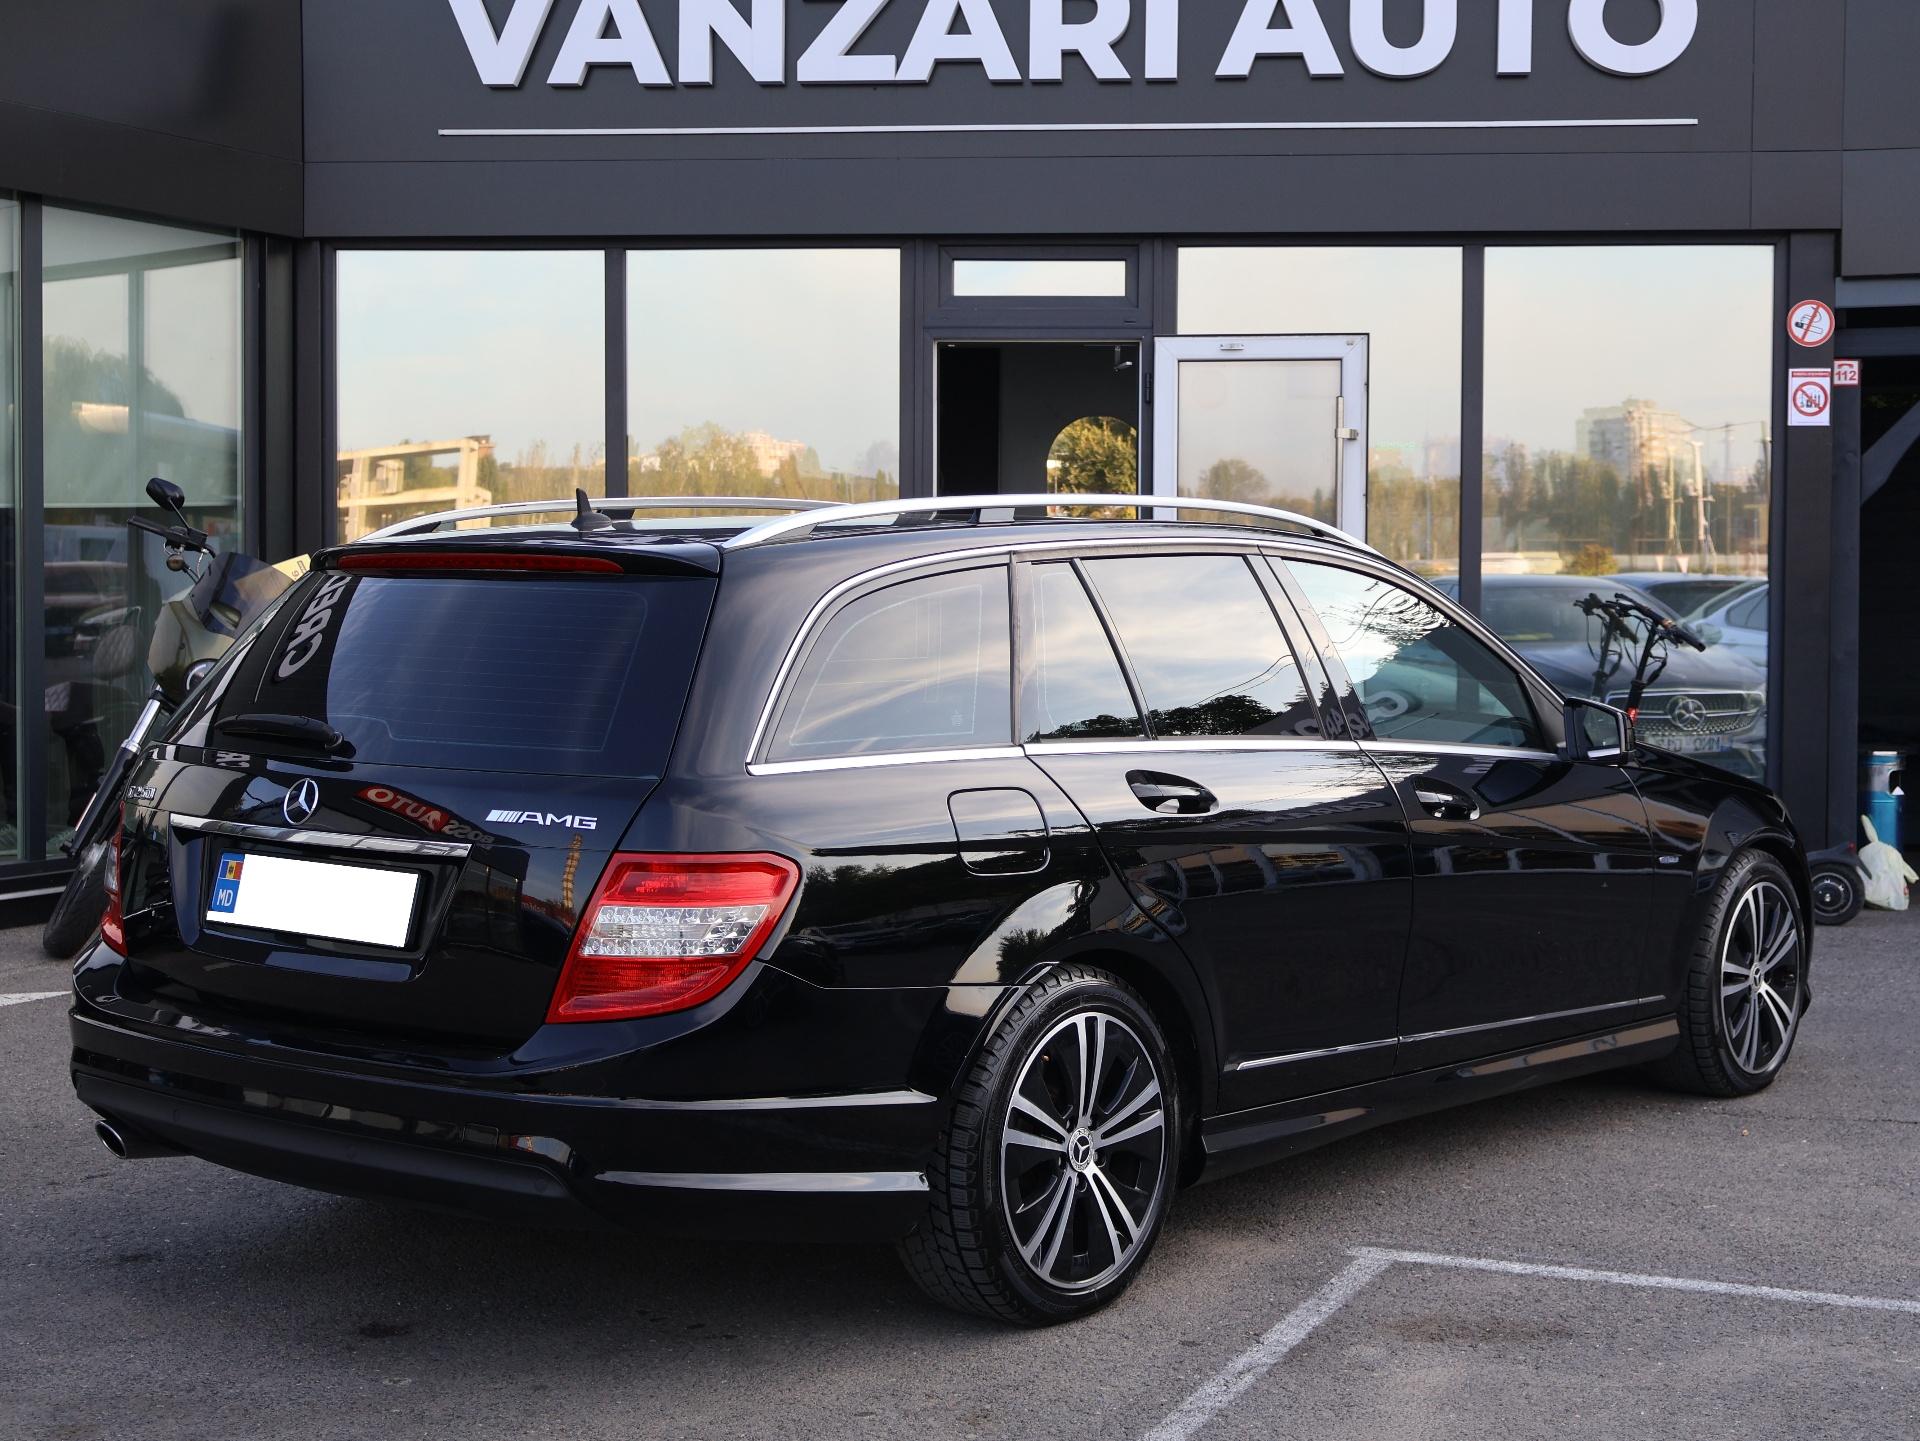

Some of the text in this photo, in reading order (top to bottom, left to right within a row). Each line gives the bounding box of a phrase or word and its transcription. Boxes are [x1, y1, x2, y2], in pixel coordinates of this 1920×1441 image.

[1214, 0, 1699, 79] AUTO
[1835, 370, 1857, 381] 112
[517, 811, 598, 830] AMG
[216, 888, 234, 907] MD
